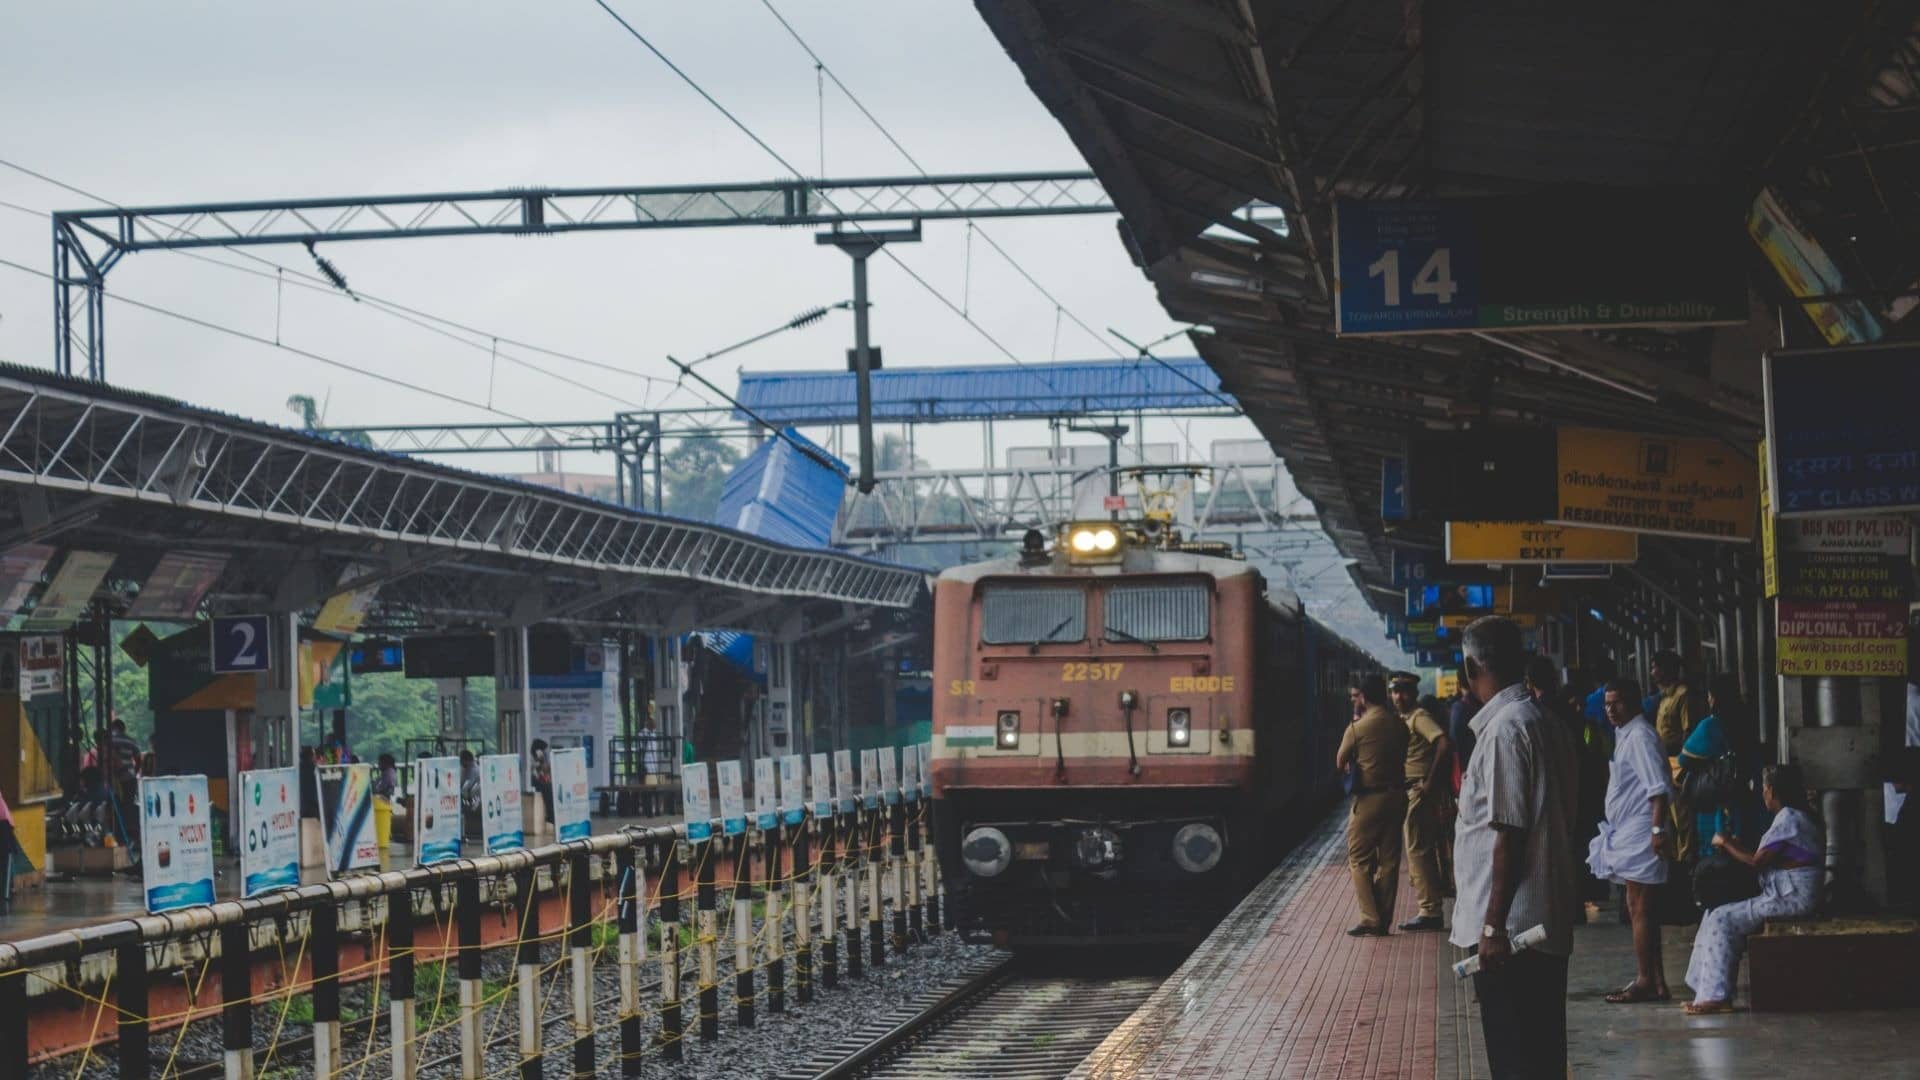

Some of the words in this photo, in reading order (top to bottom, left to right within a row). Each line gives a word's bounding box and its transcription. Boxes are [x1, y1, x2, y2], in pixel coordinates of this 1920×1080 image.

[1368, 248, 1458, 306] 14
[1503, 304, 1590, 322] Strength
[1597, 304, 1610, 319] &
[1620, 302, 1715, 320] Durability
[1818, 486, 1891, 507] CLASS
[1563, 505, 1669, 529] RESERVATION
[1674, 516, 1737, 536] CHARTS
[1520, 546, 1565, 559] EXIT
[1780, 621, 1853, 637] DIPLOMA,
[1857, 621, 1881, 637] ITI,
[1885, 621, 1904, 636] +2
[230, 621, 257, 666] 2
[1062, 662, 1124, 682] 22517
[949, 680, 977, 695] SR
[1170, 676, 1234, 693] ERODE
